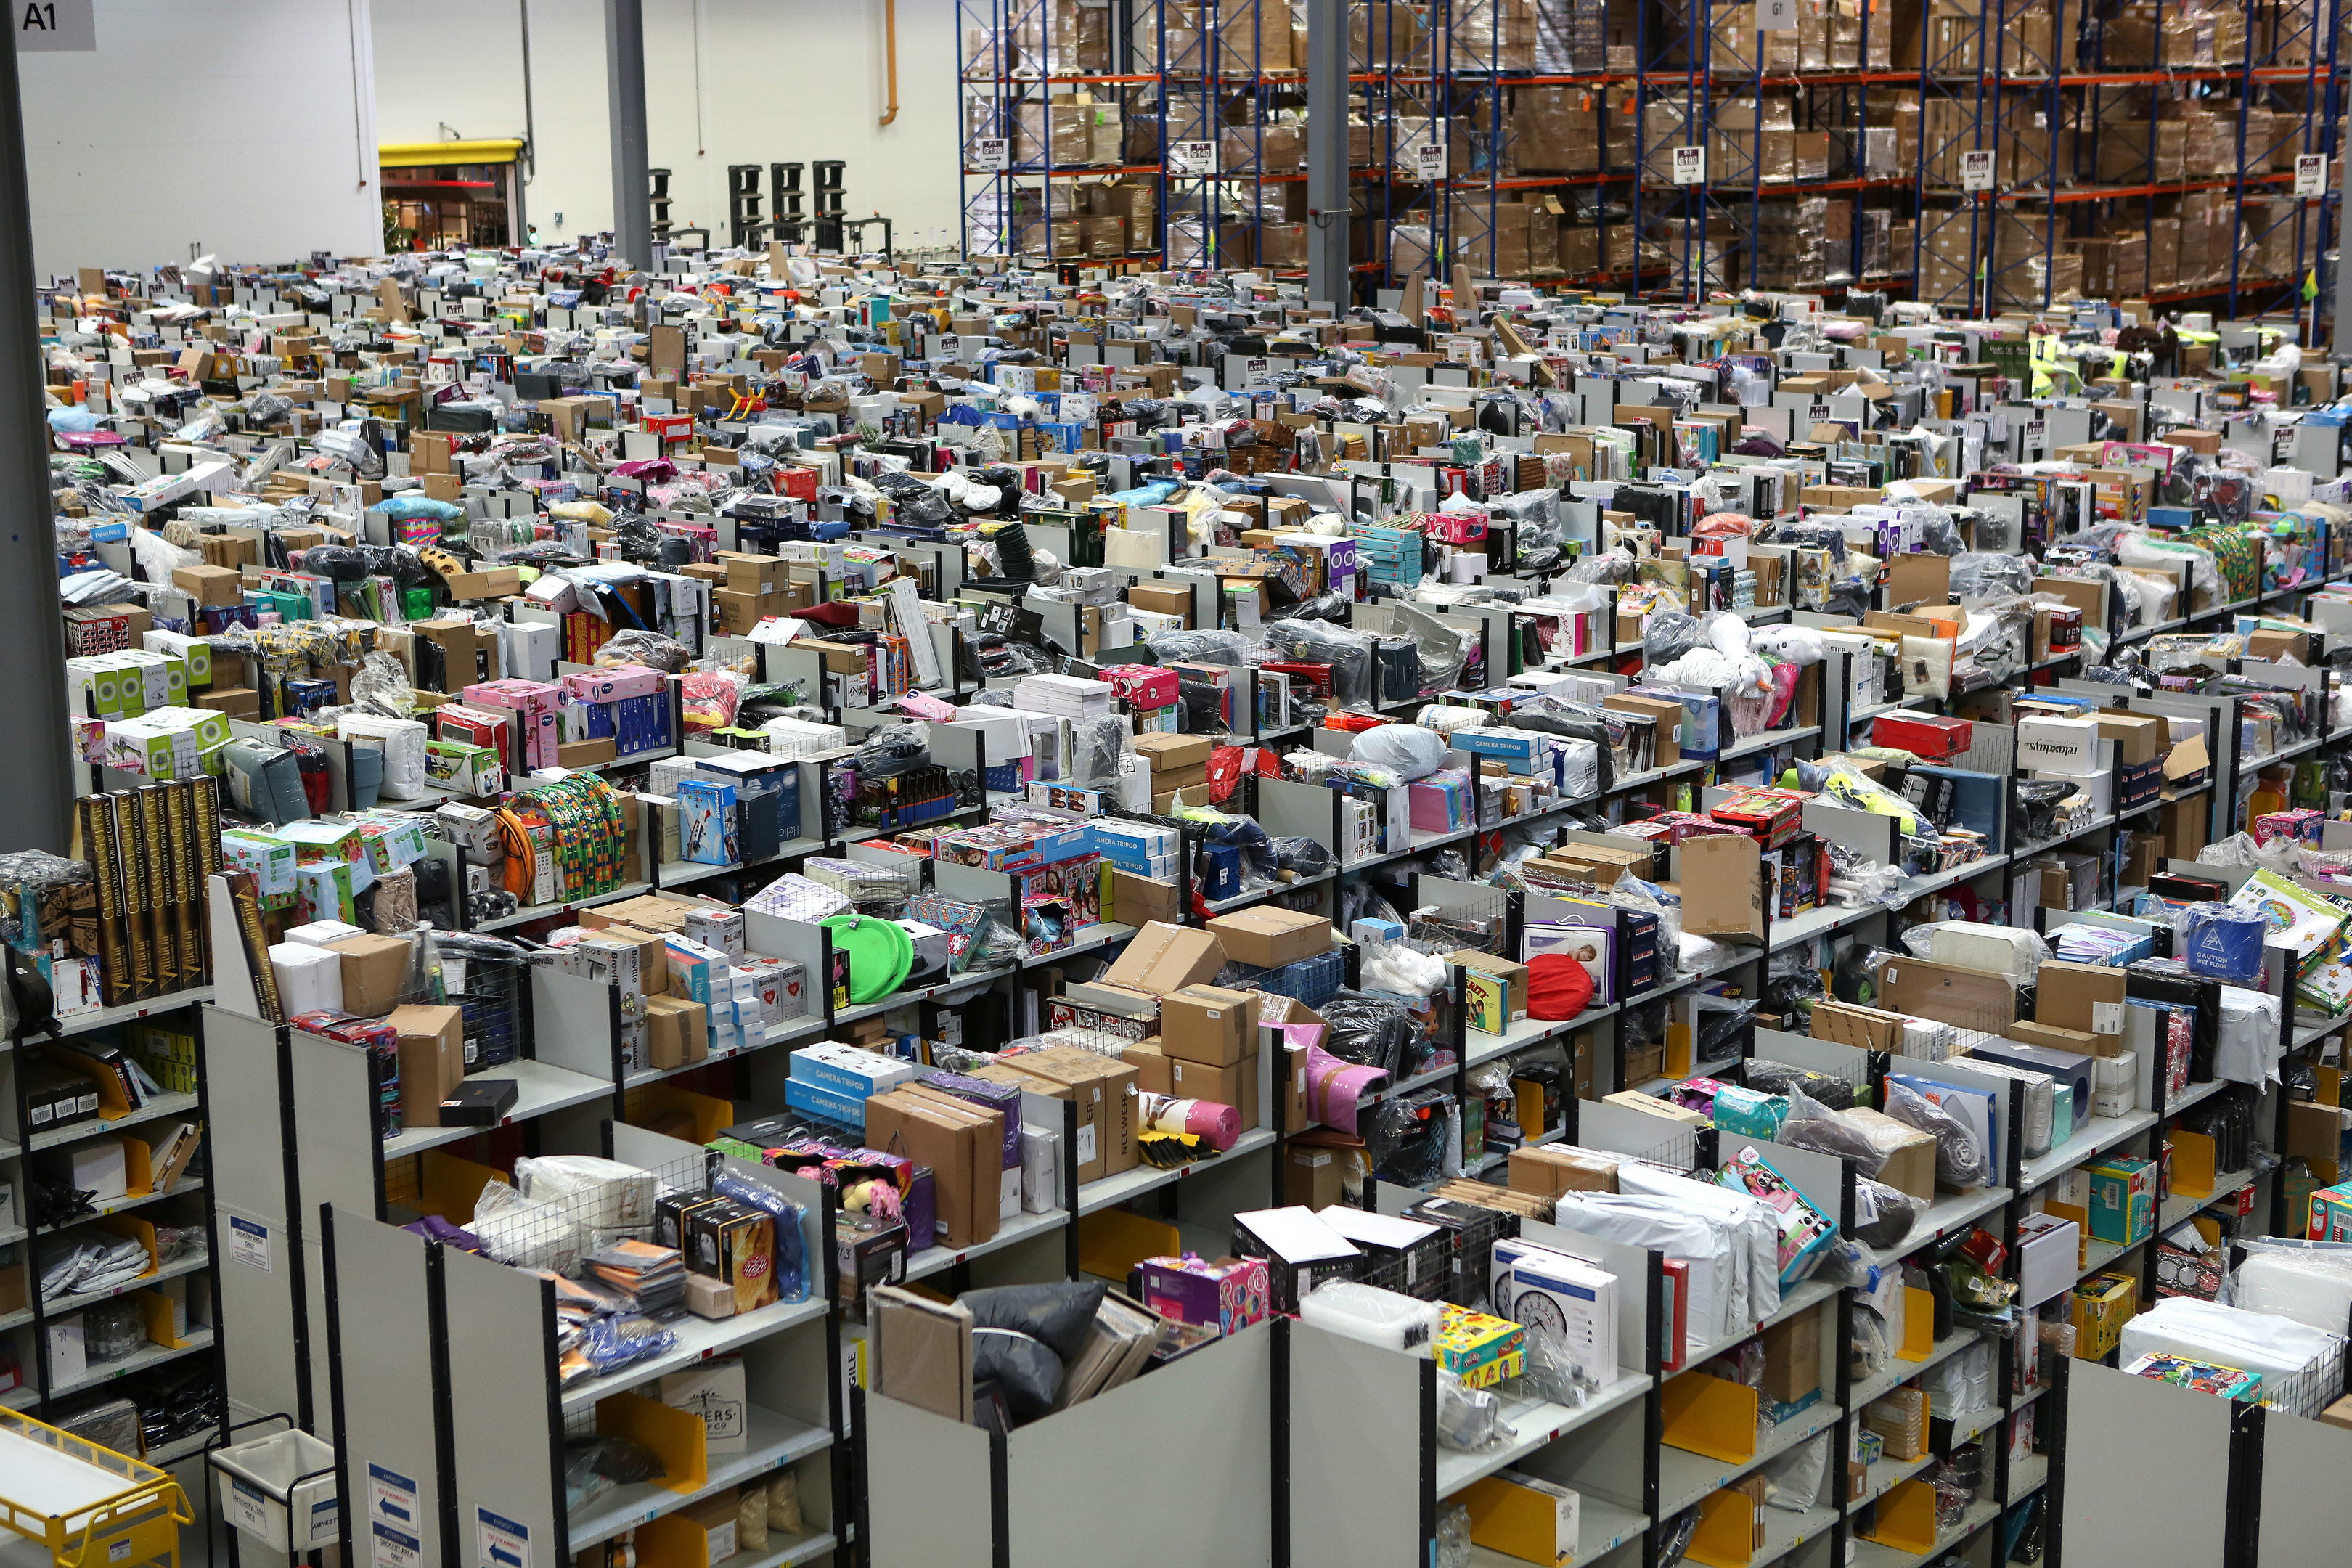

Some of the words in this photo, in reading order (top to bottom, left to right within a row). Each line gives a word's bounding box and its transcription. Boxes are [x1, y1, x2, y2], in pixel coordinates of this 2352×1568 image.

[1772, 3, 1783, 15] G1
[23, 3, 56, 30] A1
[171, 789, 181, 837] GUITAR
[197, 783, 208, 832] GUITAR
[120, 799, 134, 847] GUITAR
[146, 794, 158, 842] GUITAR
[438, 814, 460, 826] Breville
[92, 804, 107, 853] GUITAR
[1116, 840, 1138, 849] TRIPOD
[173, 840, 188, 904] CLASSICAL
[1123, 862, 1143, 871] TRIPOD
[125, 850, 139, 915] CLASSICAL
[149, 845, 163, 909] CLASSICAL
[98, 856, 114, 920] CLASSICAL
[686, 917, 707, 928] Breville
[723, 919, 742, 929] Breville
[1635, 924, 1655, 935] LEIFHEIT
[182, 930, 202, 984] Valencia
[530, 955, 554, 966] Breville
[1633, 949, 1654, 960] LEIFHEIT
[2197, 952, 2228, 964] CAUTION
[134, 941, 155, 996] Valencia
[159, 935, 178, 990] Valencia
[2209, 960, 2227, 971] FLOOR
[111, 945, 131, 1002] Valencia
[783, 969, 804, 979] Breville
[1633, 975, 1652, 986] LEIFHEIT
[759, 976, 780, 987] Breville
[815, 1069, 838, 1082] CAMERA
[840, 1077, 865, 1091] TRIPOD
[811, 1095, 834, 1108] CAMERA
[836, 1101, 861, 1116] TRIPOD
[239, 1222, 258, 1233] ATTENTION
[236, 1230, 252, 1241] GROCERY
[253, 1236, 263, 1244] AREA
[233, 1493, 254, 1514] Amnesty
[253, 1505, 264, 1518] Tote
[244, 1510, 256, 1523] Here
[313, 1517, 338, 1530] AMNEST
[384, 1530, 407, 1545] ATTENTION
[379, 1538, 400, 1553] GROCERY
[400, 1545, 415, 1559] AREA
[391, 1553, 404, 1564] ONLY
